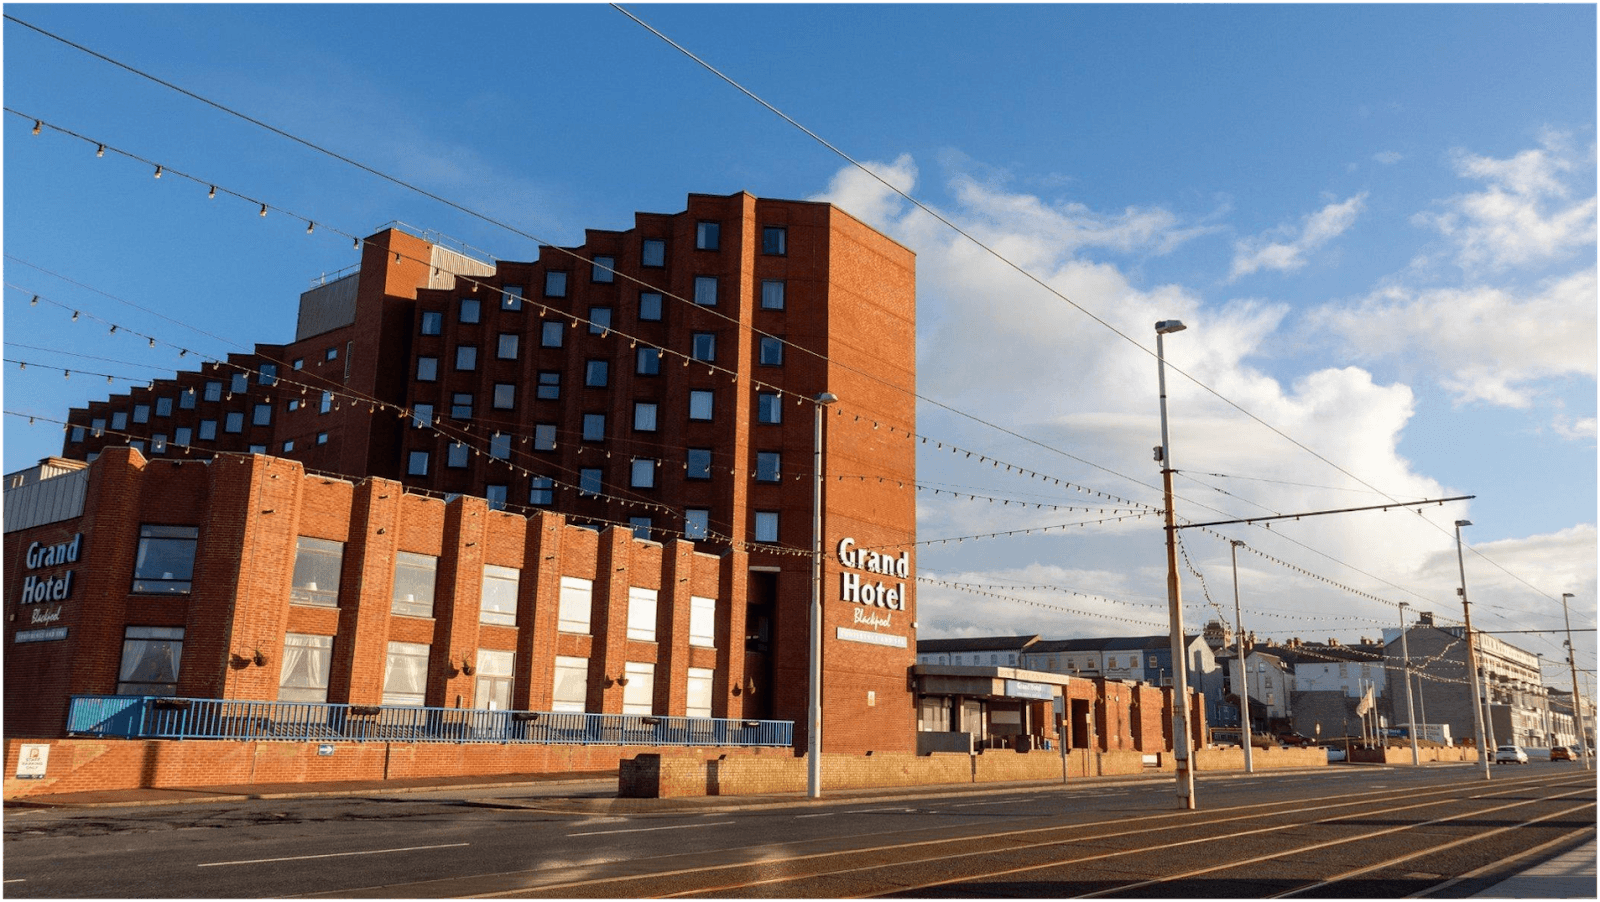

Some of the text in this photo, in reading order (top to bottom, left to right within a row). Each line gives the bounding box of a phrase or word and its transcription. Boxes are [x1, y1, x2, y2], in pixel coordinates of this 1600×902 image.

[26, 533, 81, 569] Grand
[838, 537, 909, 579] Grand
[21, 570, 71, 604] Hotel
[841, 571, 906, 611] Hotel
[31, 605, 62, 626] Blackpool
[853, 607, 892, 630] Blackpool
